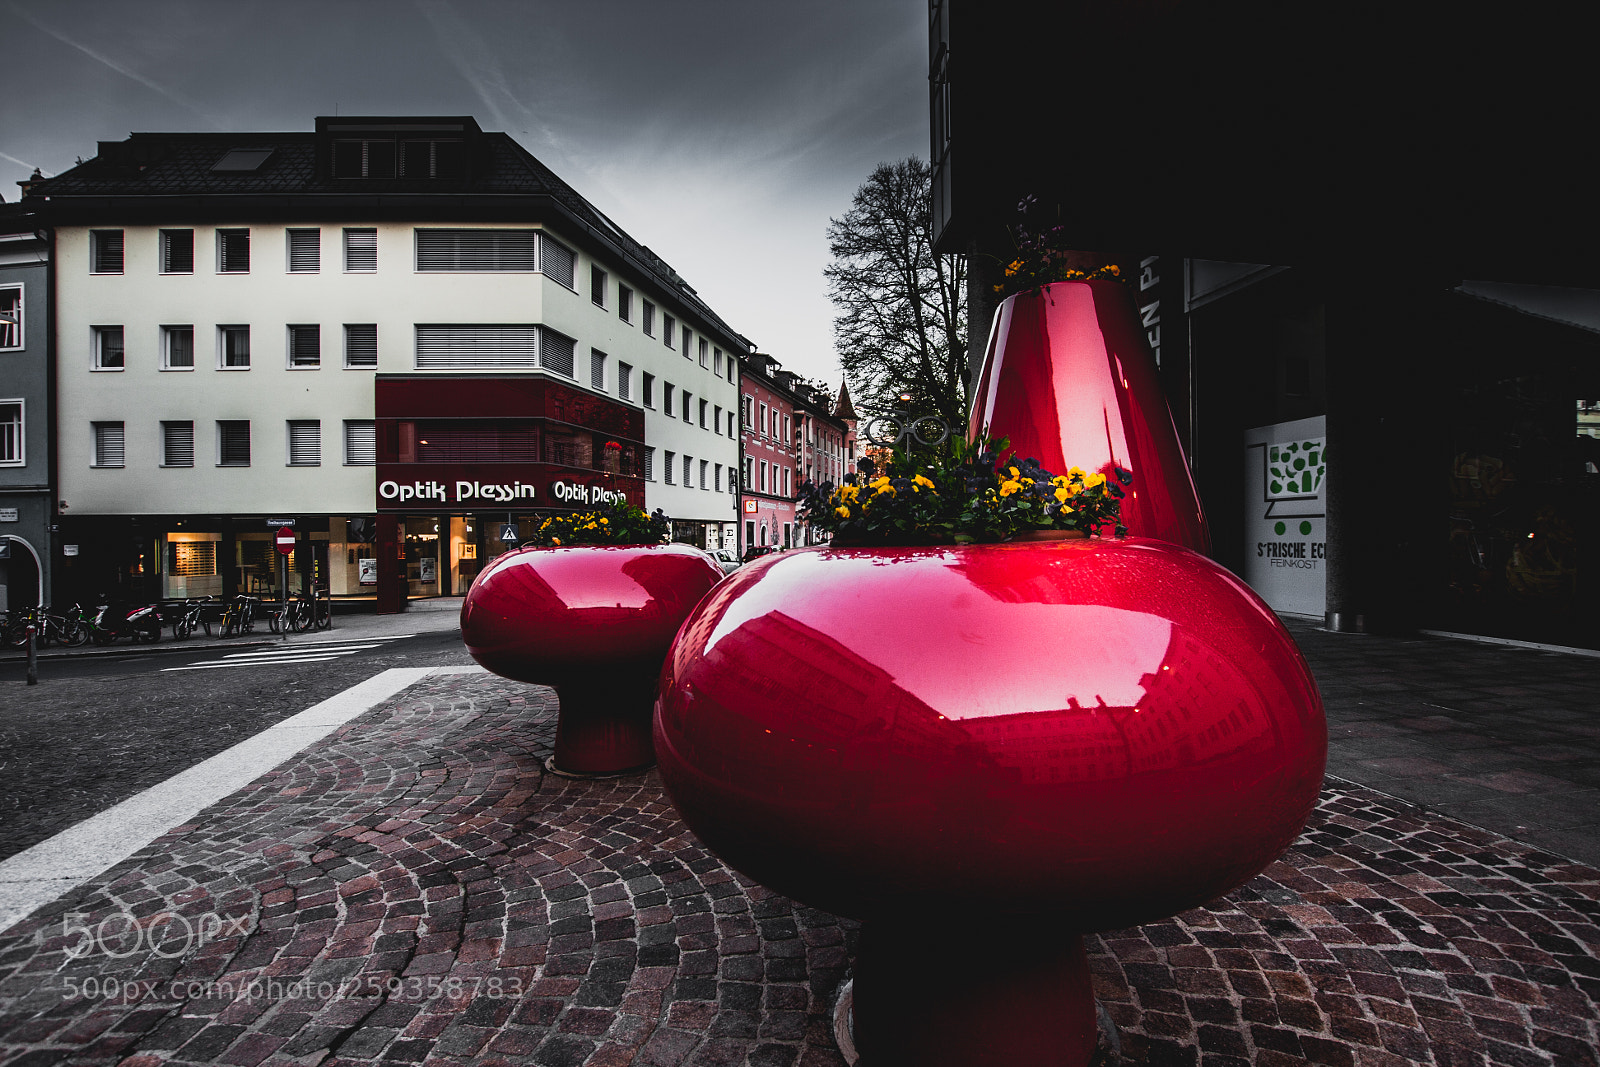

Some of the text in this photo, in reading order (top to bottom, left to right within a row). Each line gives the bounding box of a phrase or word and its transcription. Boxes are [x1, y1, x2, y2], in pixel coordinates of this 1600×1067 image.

[1141, 300, 1160, 369] EN
[379, 480, 535, 502] Optik Plessin
[554, 481, 588, 505] Optik
[1270, 558, 1318, 569] FEINKOST
